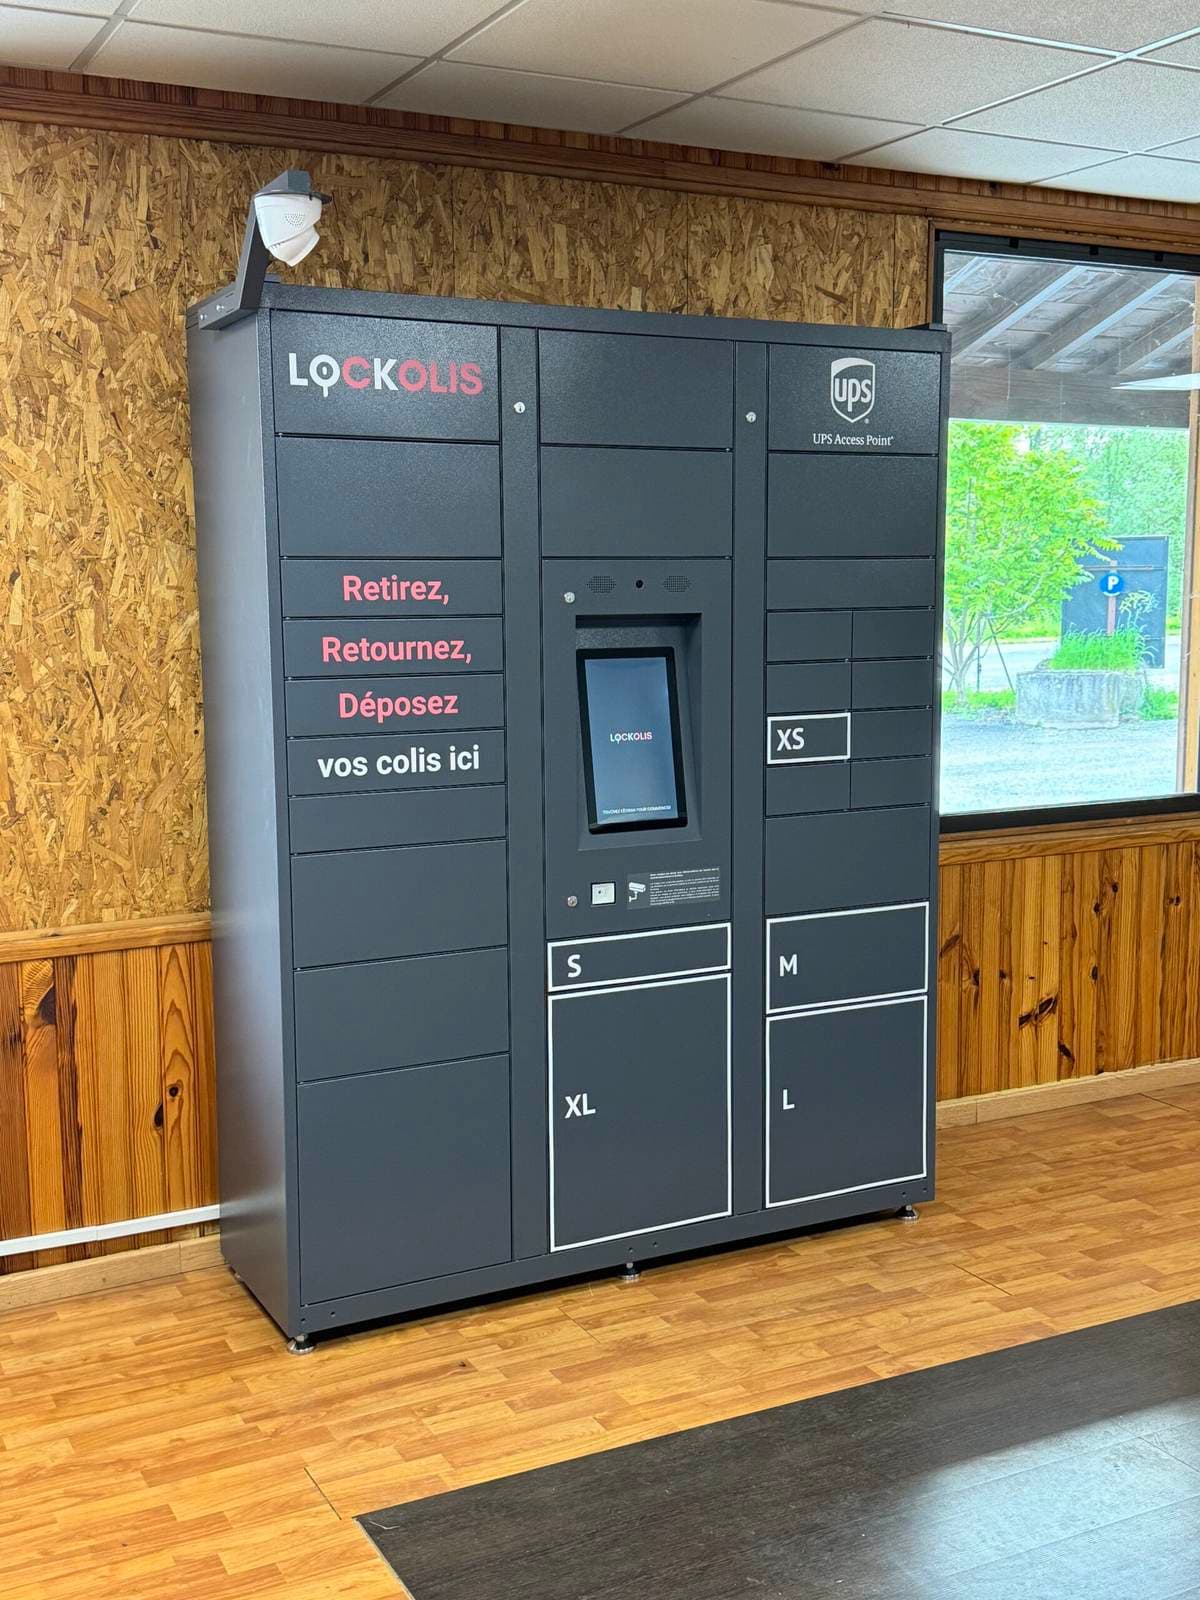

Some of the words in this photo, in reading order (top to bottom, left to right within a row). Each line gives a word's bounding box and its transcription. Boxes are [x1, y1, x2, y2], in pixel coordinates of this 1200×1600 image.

[288, 352, 484, 397] LOCKOLIS
[834, 378, 872, 412] ups
[813, 433, 832, 444] UPS
[834, 433, 865, 446] Access
[342, 574, 450, 605] Retirez,
[1107, 575, 1119, 591] P
[321, 636, 473, 664] Retournez,
[338, 691, 459, 723] Déposez
[610, 731, 653, 744] LOCKOLIS
[776, 728, 805, 751] XS
[317, 756, 368, 778] vos
[376, 746, 442, 775] colis
[449, 744, 480, 771] ici
[567, 954, 582, 978] S
[779, 954, 798, 977] M
[564, 1092, 597, 1119] XL
[782, 1088, 795, 1111] L
